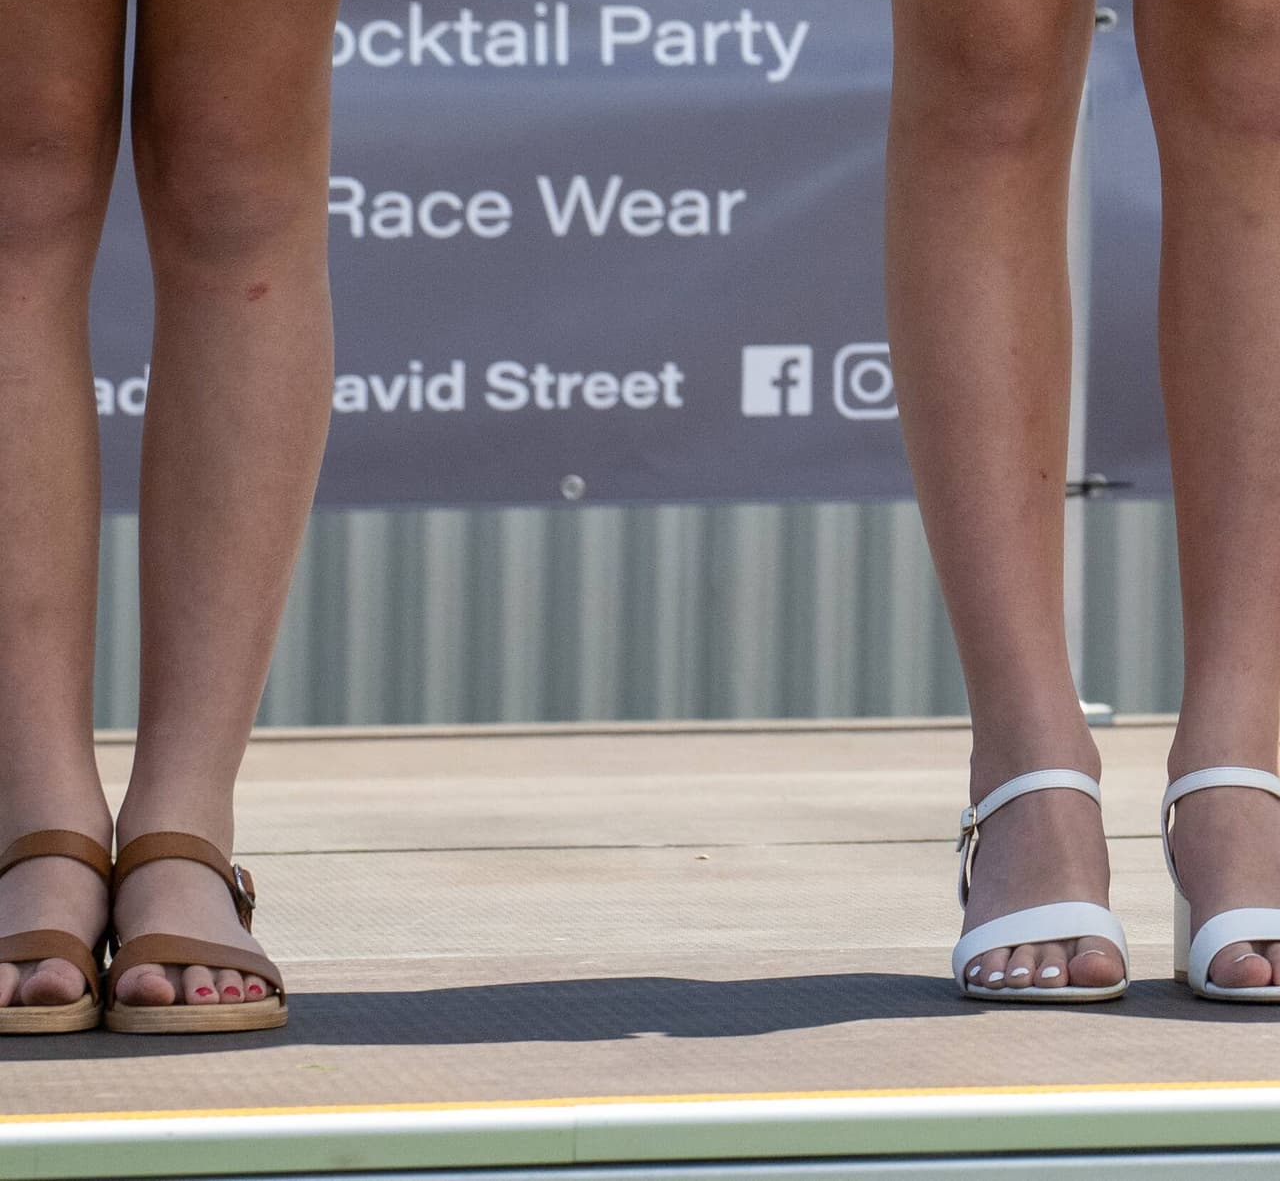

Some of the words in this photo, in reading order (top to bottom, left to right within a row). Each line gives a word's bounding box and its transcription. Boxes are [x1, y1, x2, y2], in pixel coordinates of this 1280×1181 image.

[333, 1, 568, 68] ocktail
[600, 3, 811, 83] Party
[328, 175, 513, 239] Race
[536, 174, 747, 237] Wear
[332, 359, 466, 412] avid
[484, 360, 684, 410] Street
